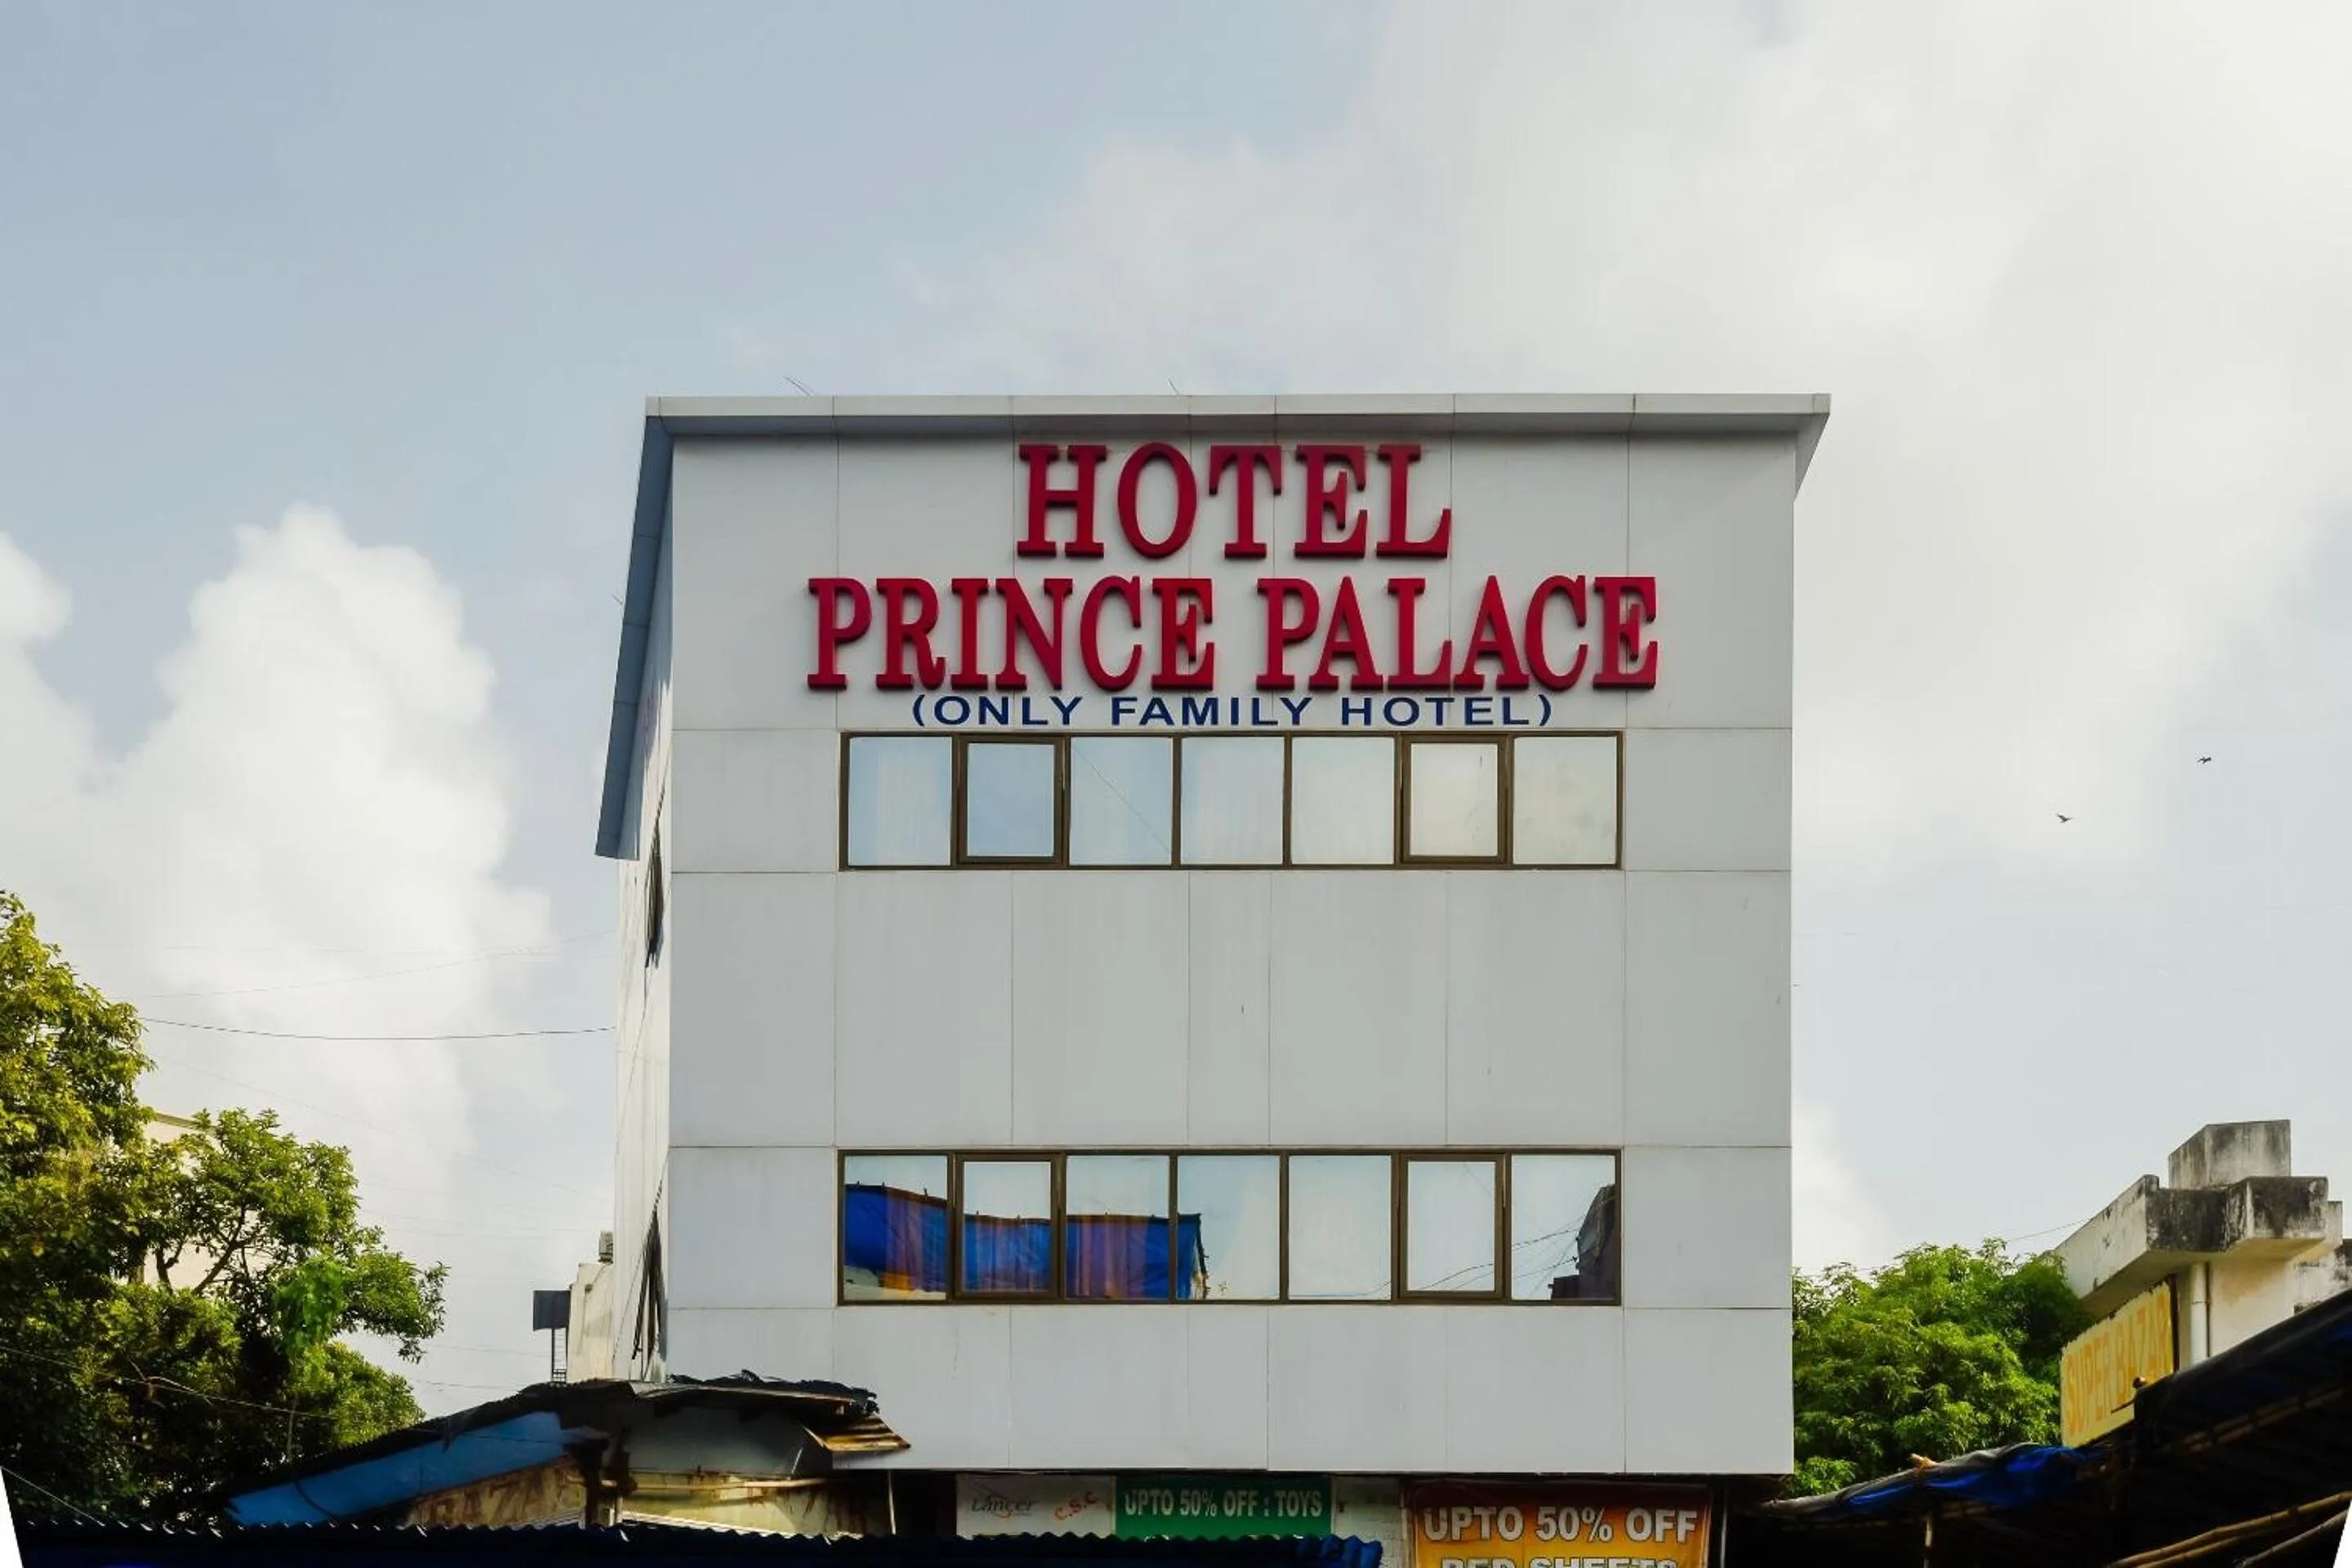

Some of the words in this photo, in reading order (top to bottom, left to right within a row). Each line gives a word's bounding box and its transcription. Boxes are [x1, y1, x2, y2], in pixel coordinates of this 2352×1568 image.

[1017, 442, 1452, 560] HOTEL
[807, 575, 1215, 693] PRINCE
[1255, 575, 1659, 692] PALACE
[912, 695, 1083, 728] (ONLY
[1111, 696, 1312, 727] FAMILY
[1339, 695, 1553, 728] HOTEL)
[1125, 1489, 1174, 1516] UPTO
[1179, 1489, 1217, 1517] 50%
[1223, 1490, 1258, 1517] OFF
[1275, 1490, 1323, 1517] TOYS
[1423, 1506, 1524, 1542] UPTO
[1535, 1507, 1613, 1543] 50%
[1625, 1508, 1698, 1544] OFF
